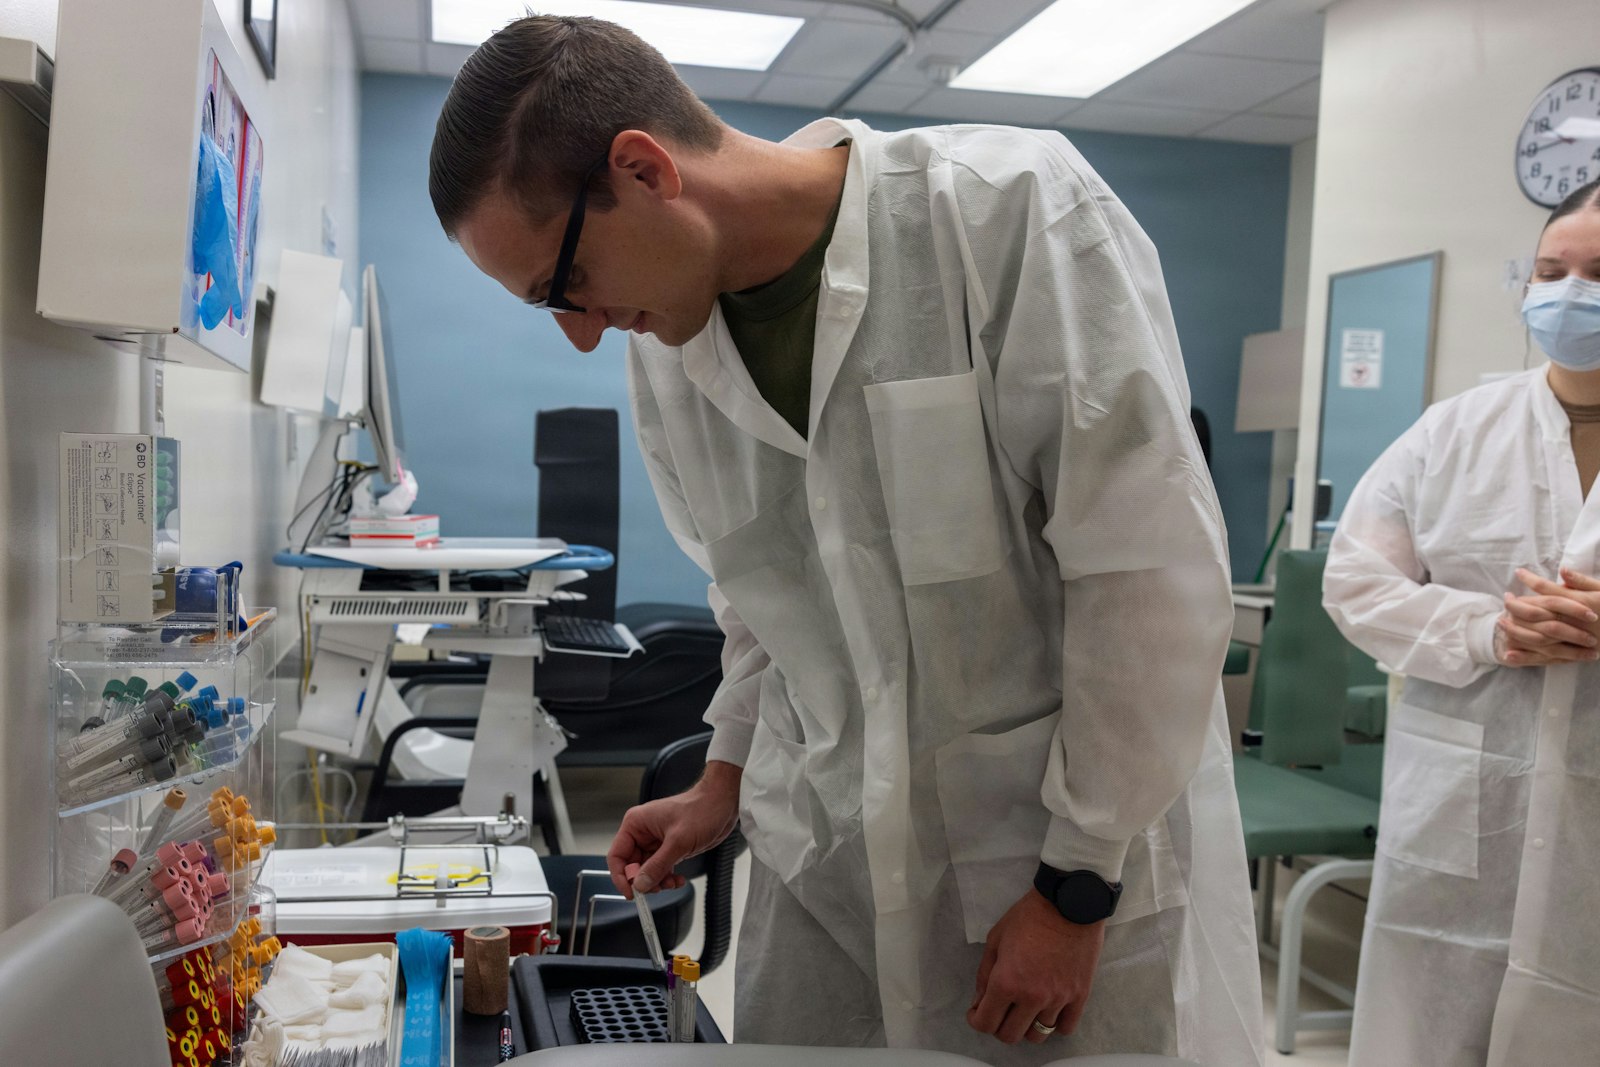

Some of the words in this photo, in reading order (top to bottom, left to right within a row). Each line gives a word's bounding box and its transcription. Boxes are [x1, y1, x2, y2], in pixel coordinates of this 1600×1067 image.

[1566, 84, 1582, 101] 12
[1589, 86, 1595, 101] 1
[1549, 98, 1561, 113] 11
[1526, 142, 1539, 158] 9
[1530, 162, 1541, 178] 8
[1576, 166, 1588, 183] 5
[1543, 175, 1553, 190] 7
[1557, 178, 1569, 194] 6
[137, 454, 146, 469] BD
